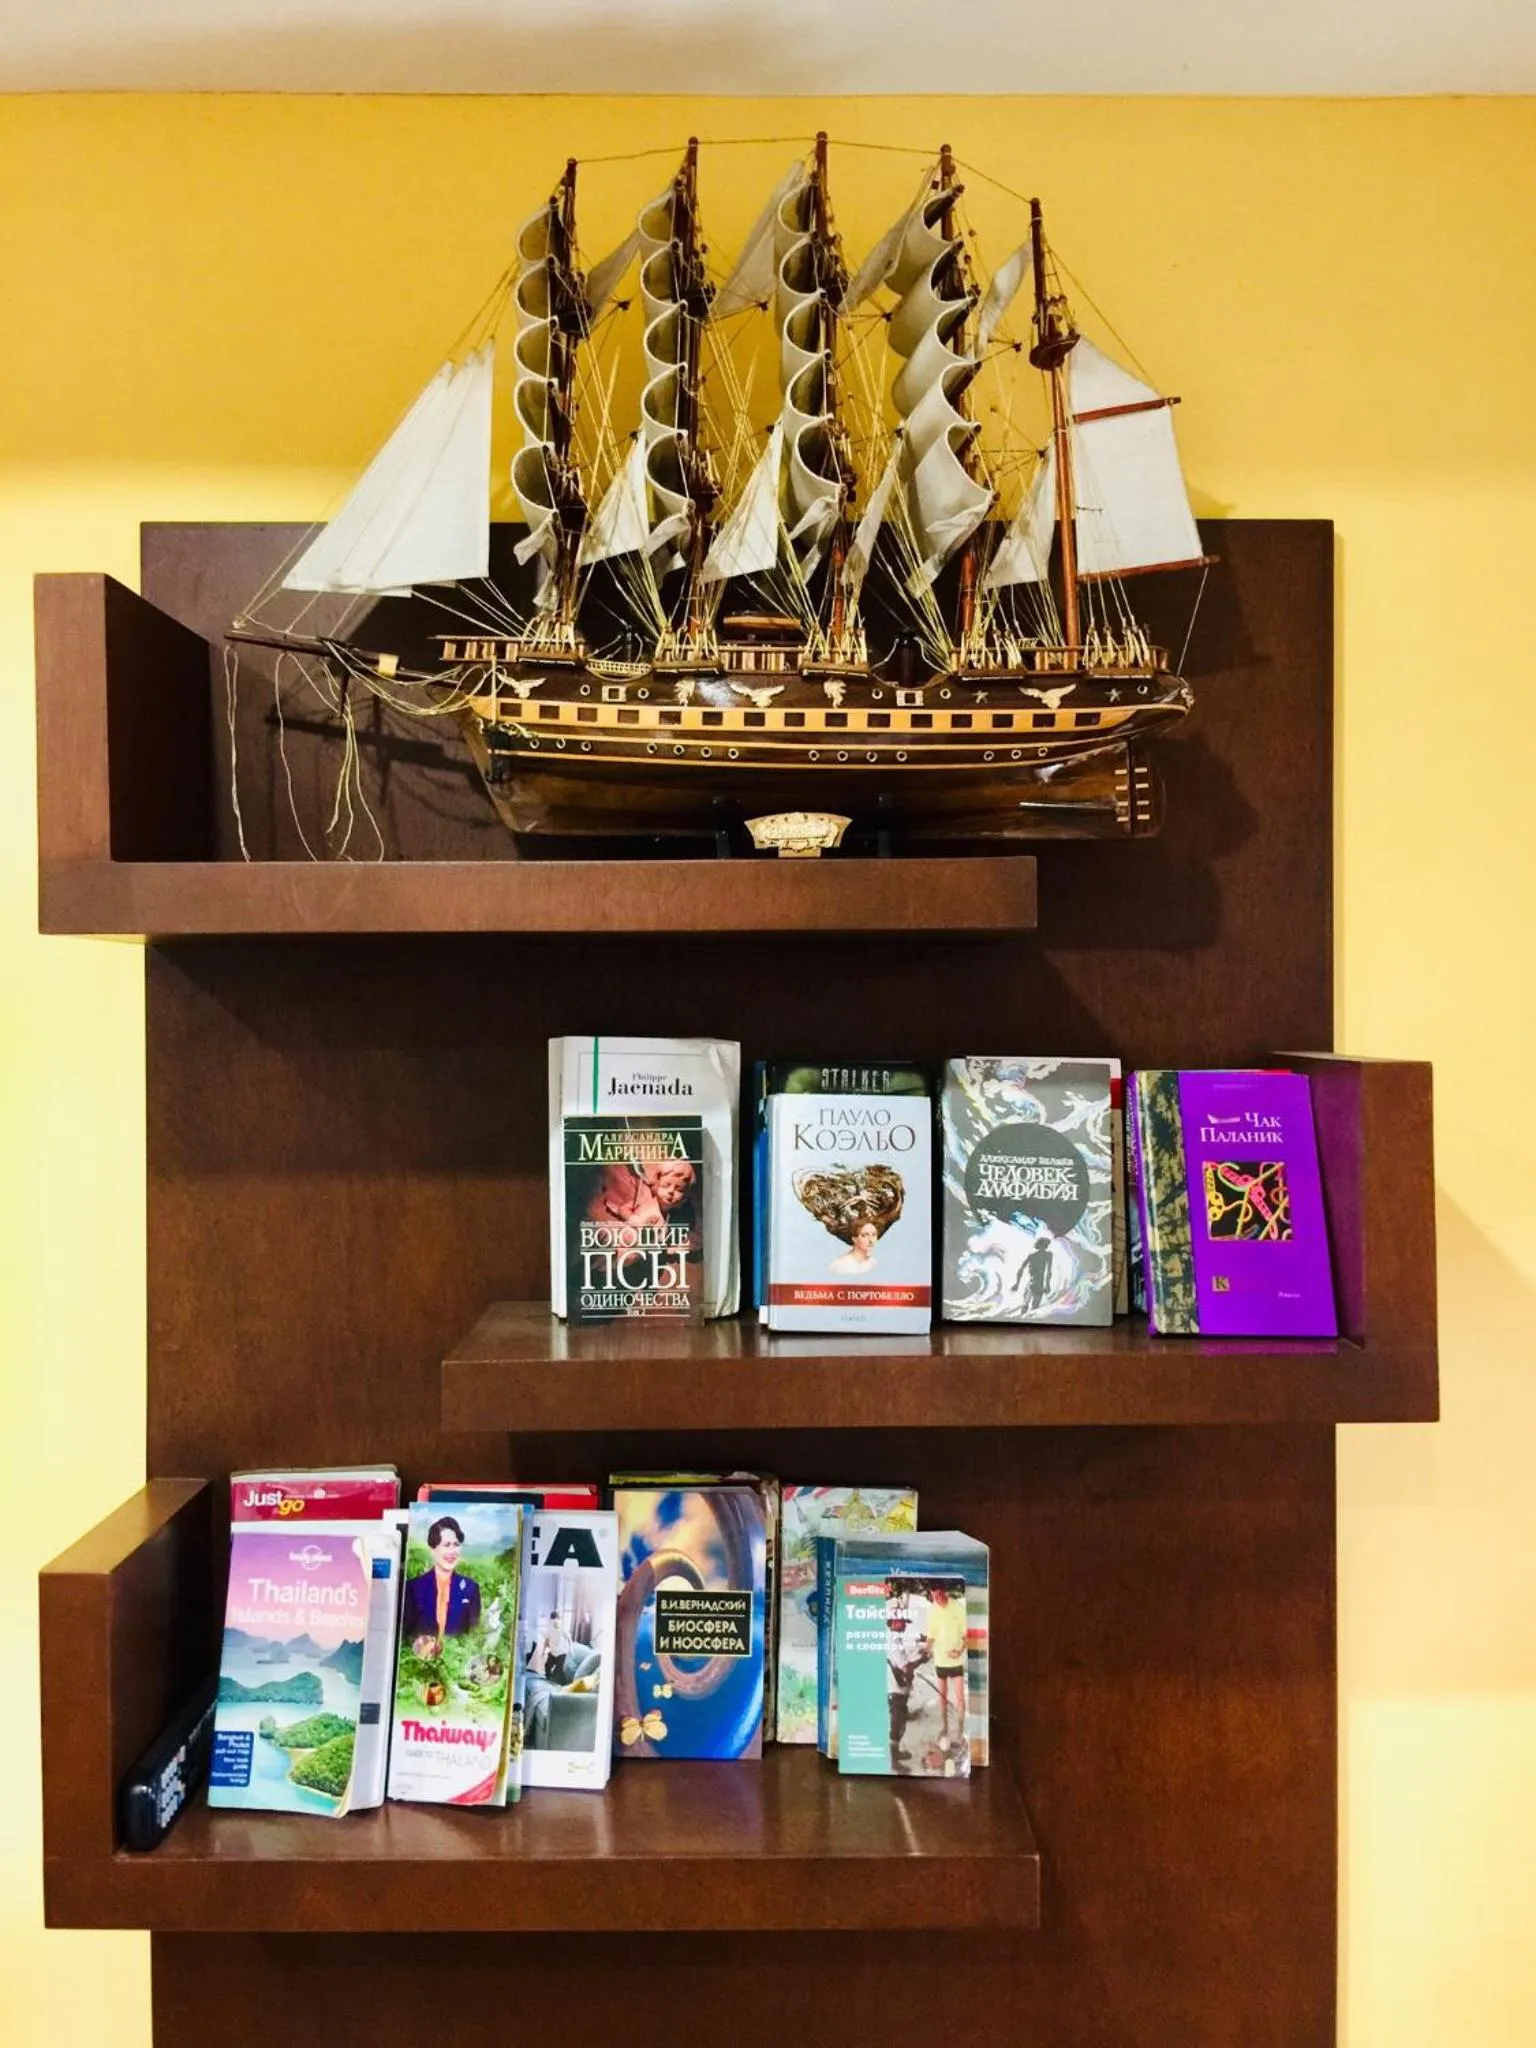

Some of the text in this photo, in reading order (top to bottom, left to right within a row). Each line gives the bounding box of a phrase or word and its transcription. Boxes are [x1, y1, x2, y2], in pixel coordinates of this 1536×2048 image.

[608, 1076, 694, 1096] Jaenada
[819, 1108, 891, 1126] ПАУЛО
[602, 1131, 674, 1143] АЛЕКСАНДРА
[793, 1124, 917, 1152] КОЭЛЬО
[978, 1163, 1077, 1184] ЧЕЛОВЕК-
[973, 1178, 1080, 1201] АМФИБИЯ
[580, 1226, 690, 1248] ВОЮЩИЕ
[580, 1250, 691, 1290] ПСЫ
[580, 1292, 691, 1309] ОДИНОЧЕСТВА
[794, 1290, 915, 1302] ВЕДЬМА С ПОРТОБЕЛЛО
[244, 1489, 283, 1507] Just
[278, 1499, 305, 1516] go
[248, 1577, 359, 1607] Thailand's
[668, 1619, 738, 1634] БИОСФЕРА
[660, 1637, 745, 1651] И НООСФЕРА
